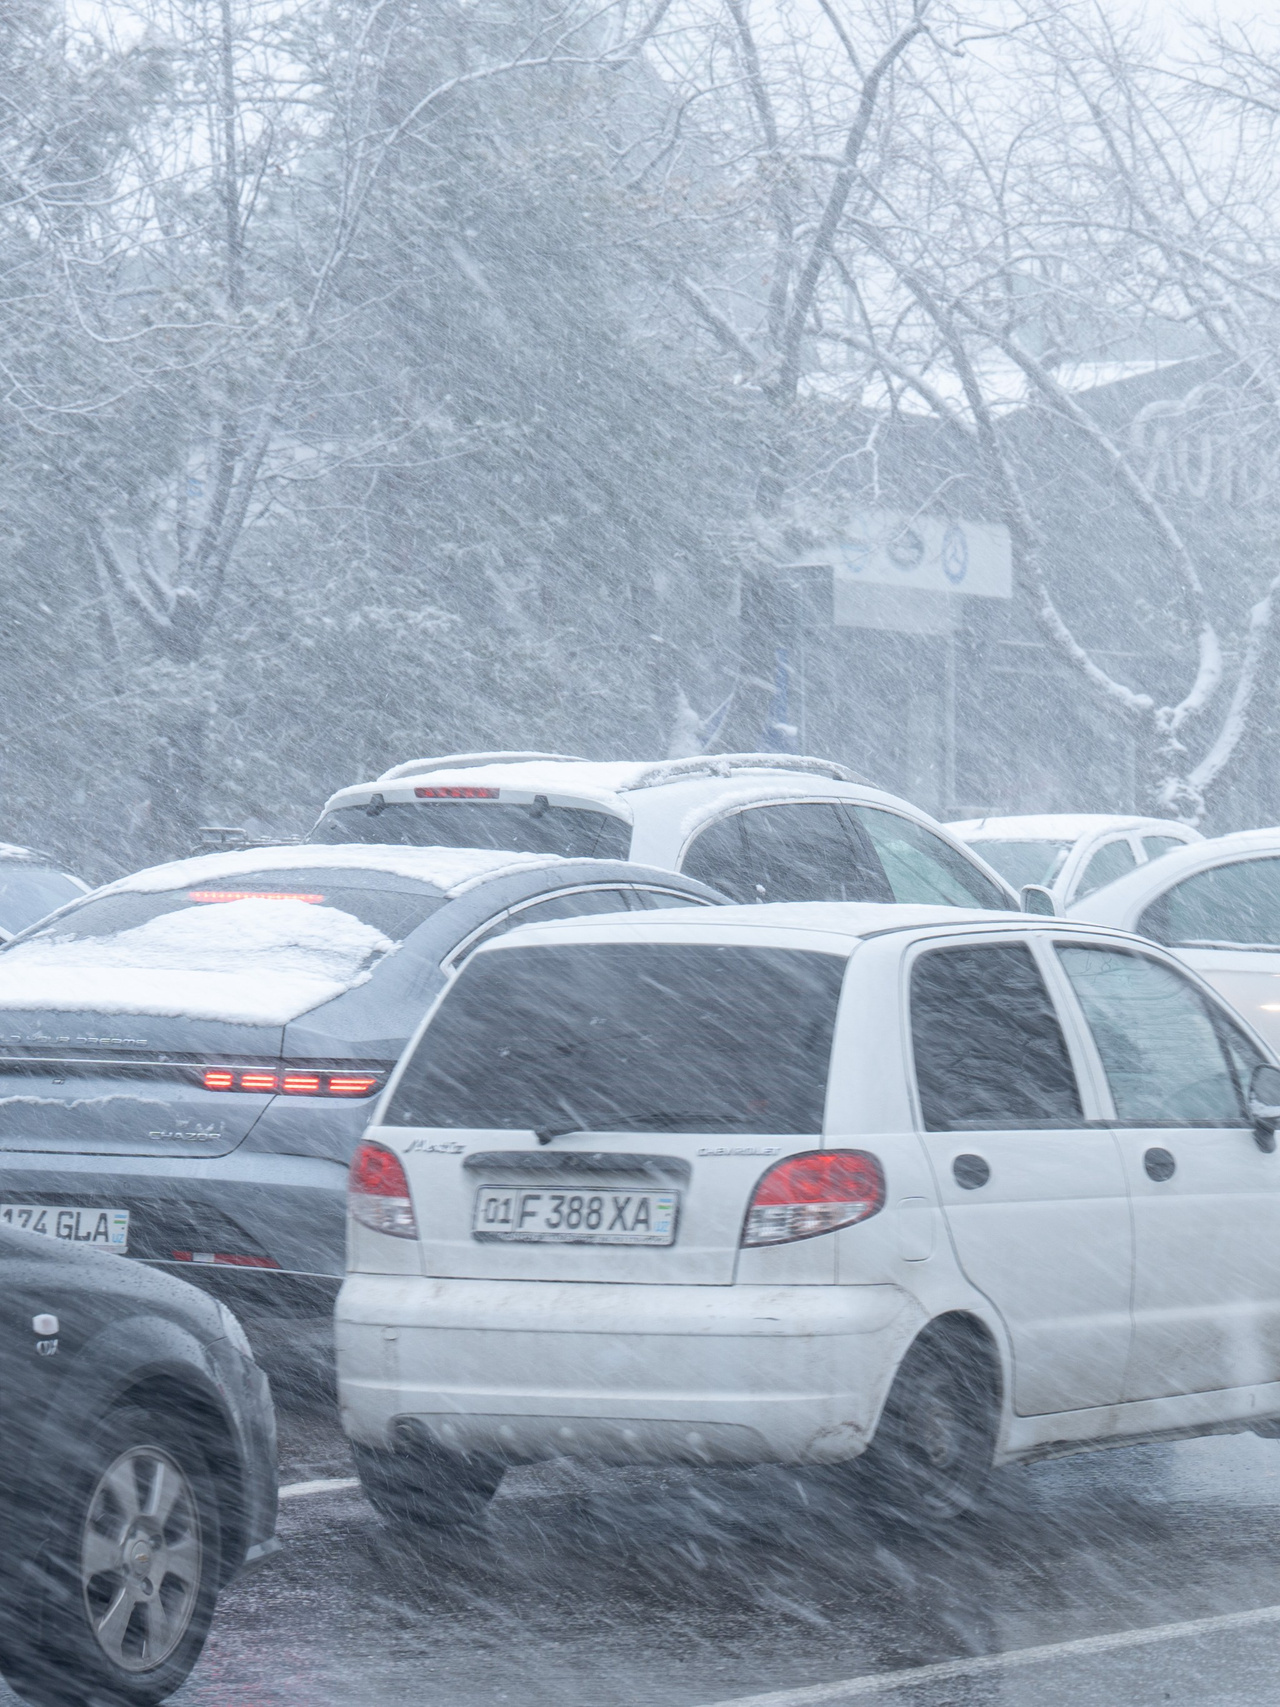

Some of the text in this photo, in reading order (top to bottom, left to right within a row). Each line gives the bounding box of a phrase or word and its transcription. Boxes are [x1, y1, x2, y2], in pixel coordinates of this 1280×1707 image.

[76, 1036, 147, 1046] DREAMS
[148, 1131, 222, 1141] CHAZOR
[697, 1147, 781, 1157] CHEVROLET
[484, 1198, 513, 1224] 01
[55, 1210, 109, 1242] GLA
